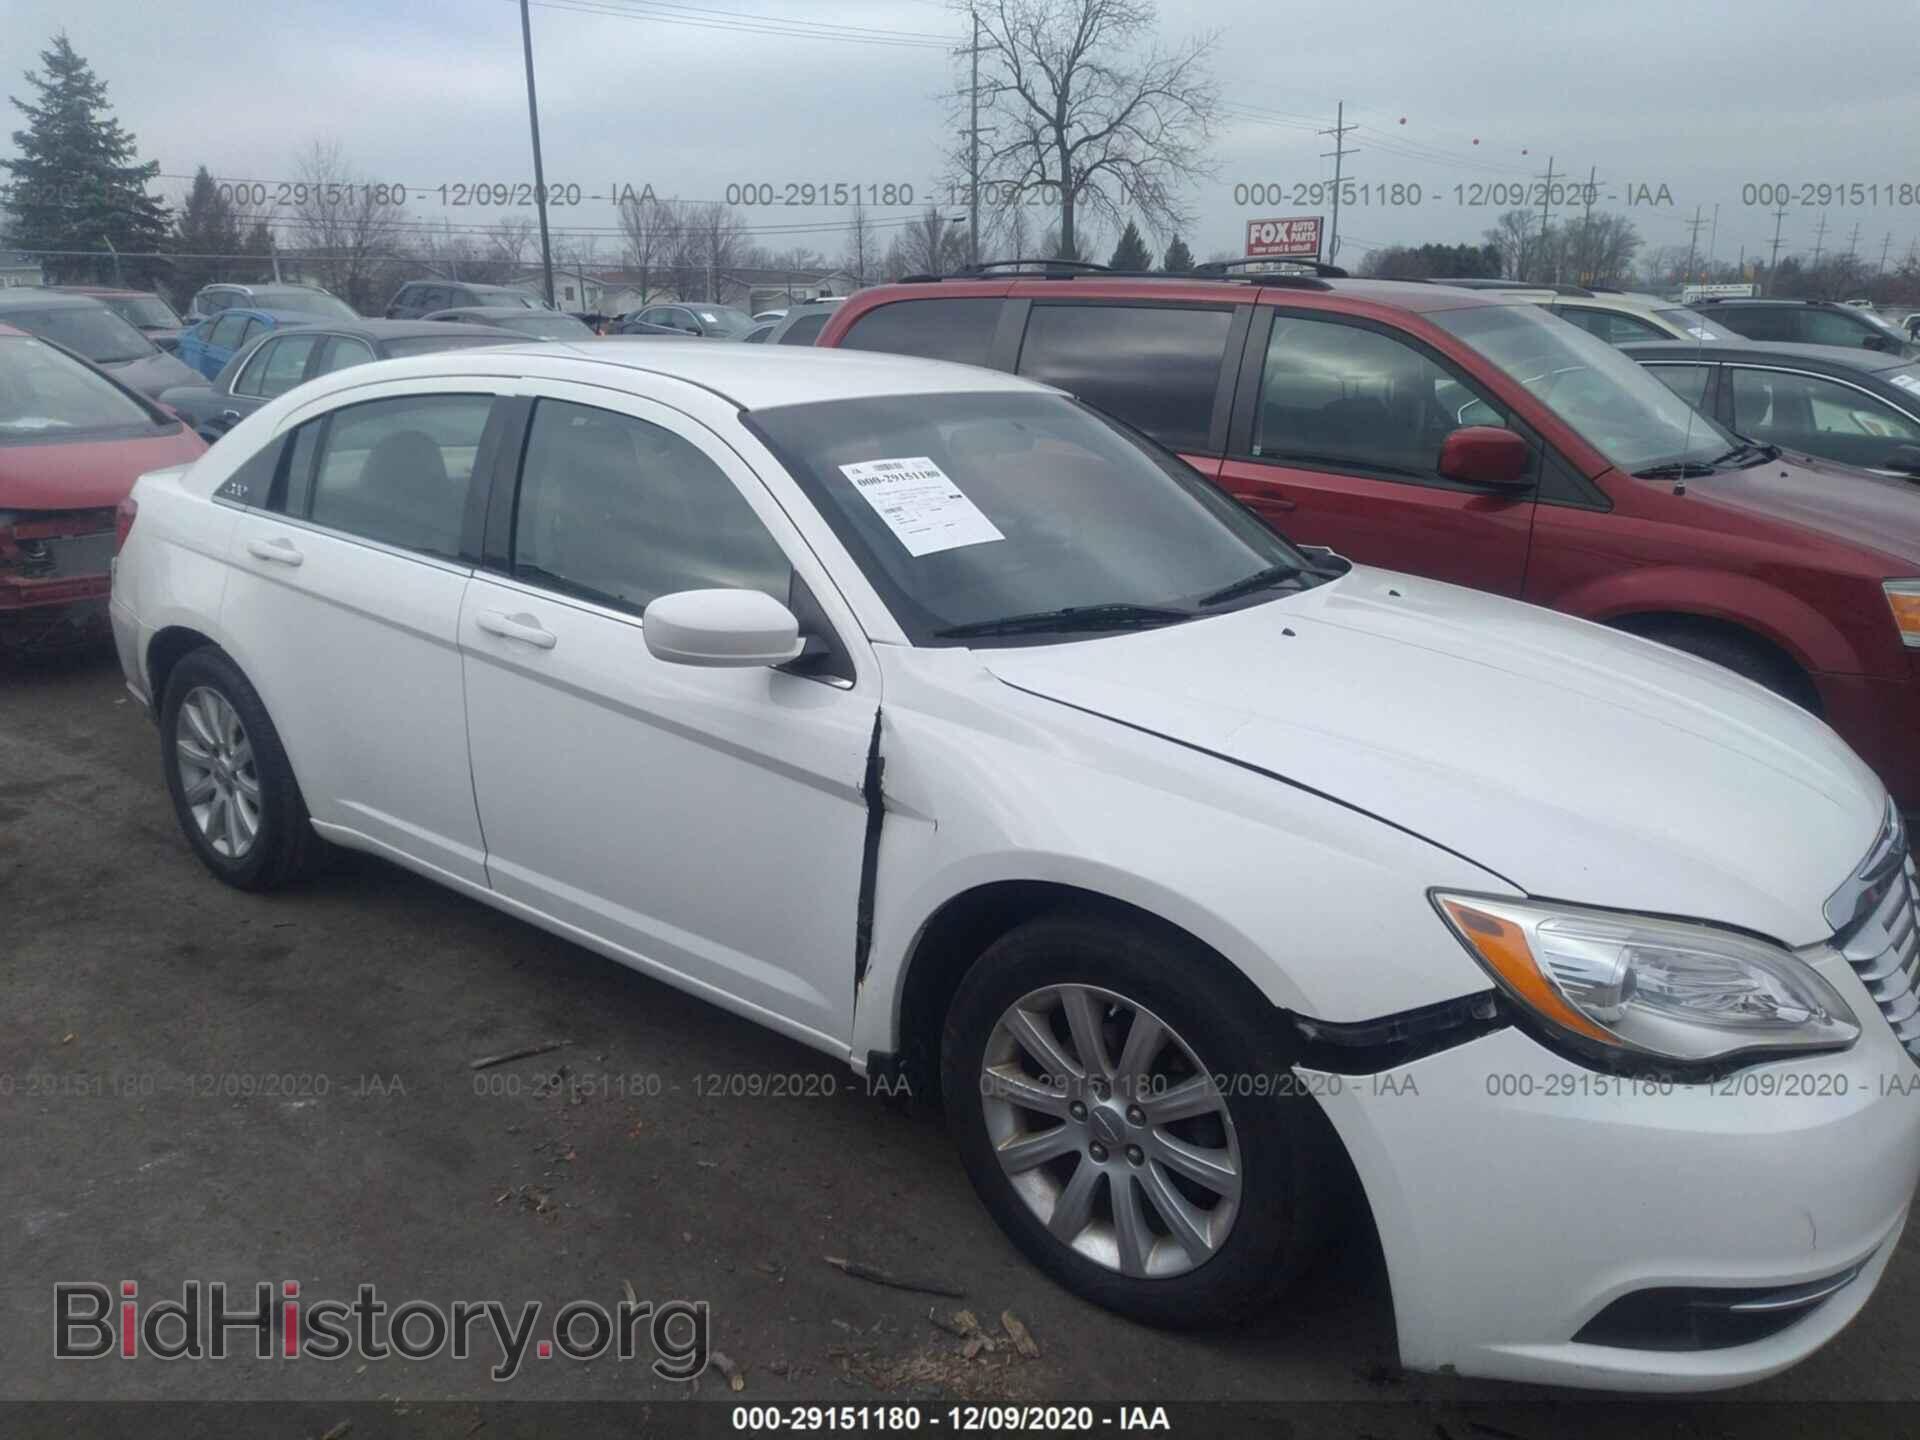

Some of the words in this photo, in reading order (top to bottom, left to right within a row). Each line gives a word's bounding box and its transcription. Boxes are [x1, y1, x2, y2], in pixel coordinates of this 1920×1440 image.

[1250, 223, 1290, 244] FOX
[1291, 221, 1315, 231] AUTO
[1291, 231, 1316, 242] PARTS
